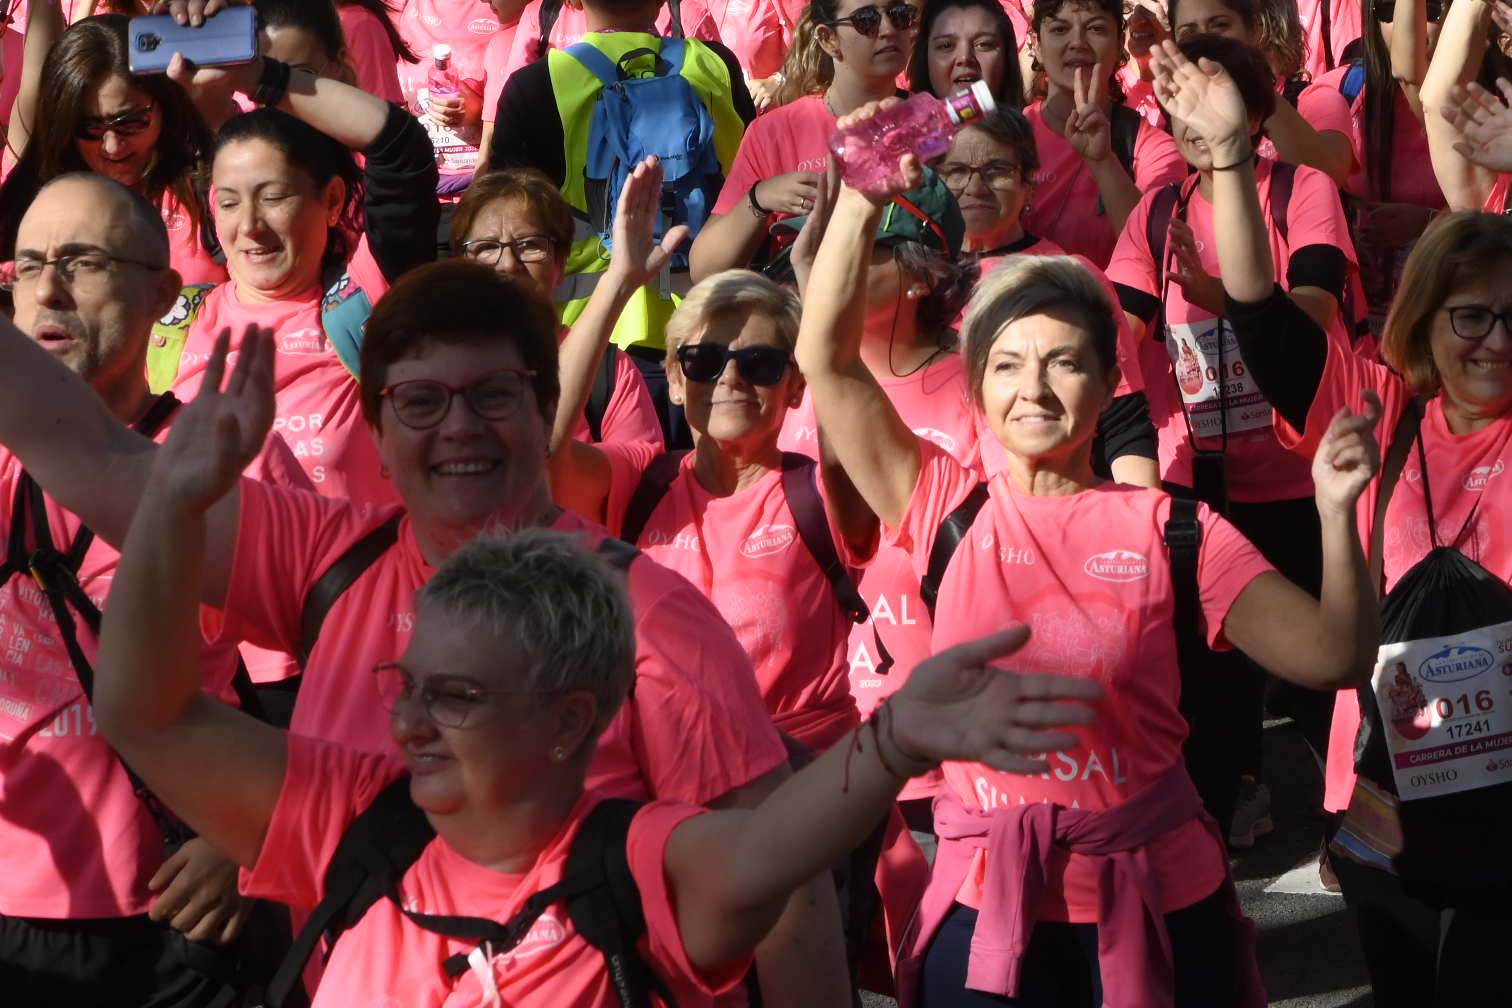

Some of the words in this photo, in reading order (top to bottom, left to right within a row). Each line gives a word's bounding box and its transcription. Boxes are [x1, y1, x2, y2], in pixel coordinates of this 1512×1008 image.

[294, 438, 324, 458] AS
[311, 465, 326, 483] S
[1089, 559, 1147, 575] ASTURIANA
[8, 636, 31, 653] LEN
[1425, 657, 1489, 679] ASTURIANA
[1435, 689, 1495, 721] 016
[1446, 719, 1491, 739] 17241
[1409, 749, 1453, 764] CARRERA
[1454, 744, 1468, 755] DE
[1470, 742, 1484, 753] LA
[1410, 768, 1458, 788] OYSHO
